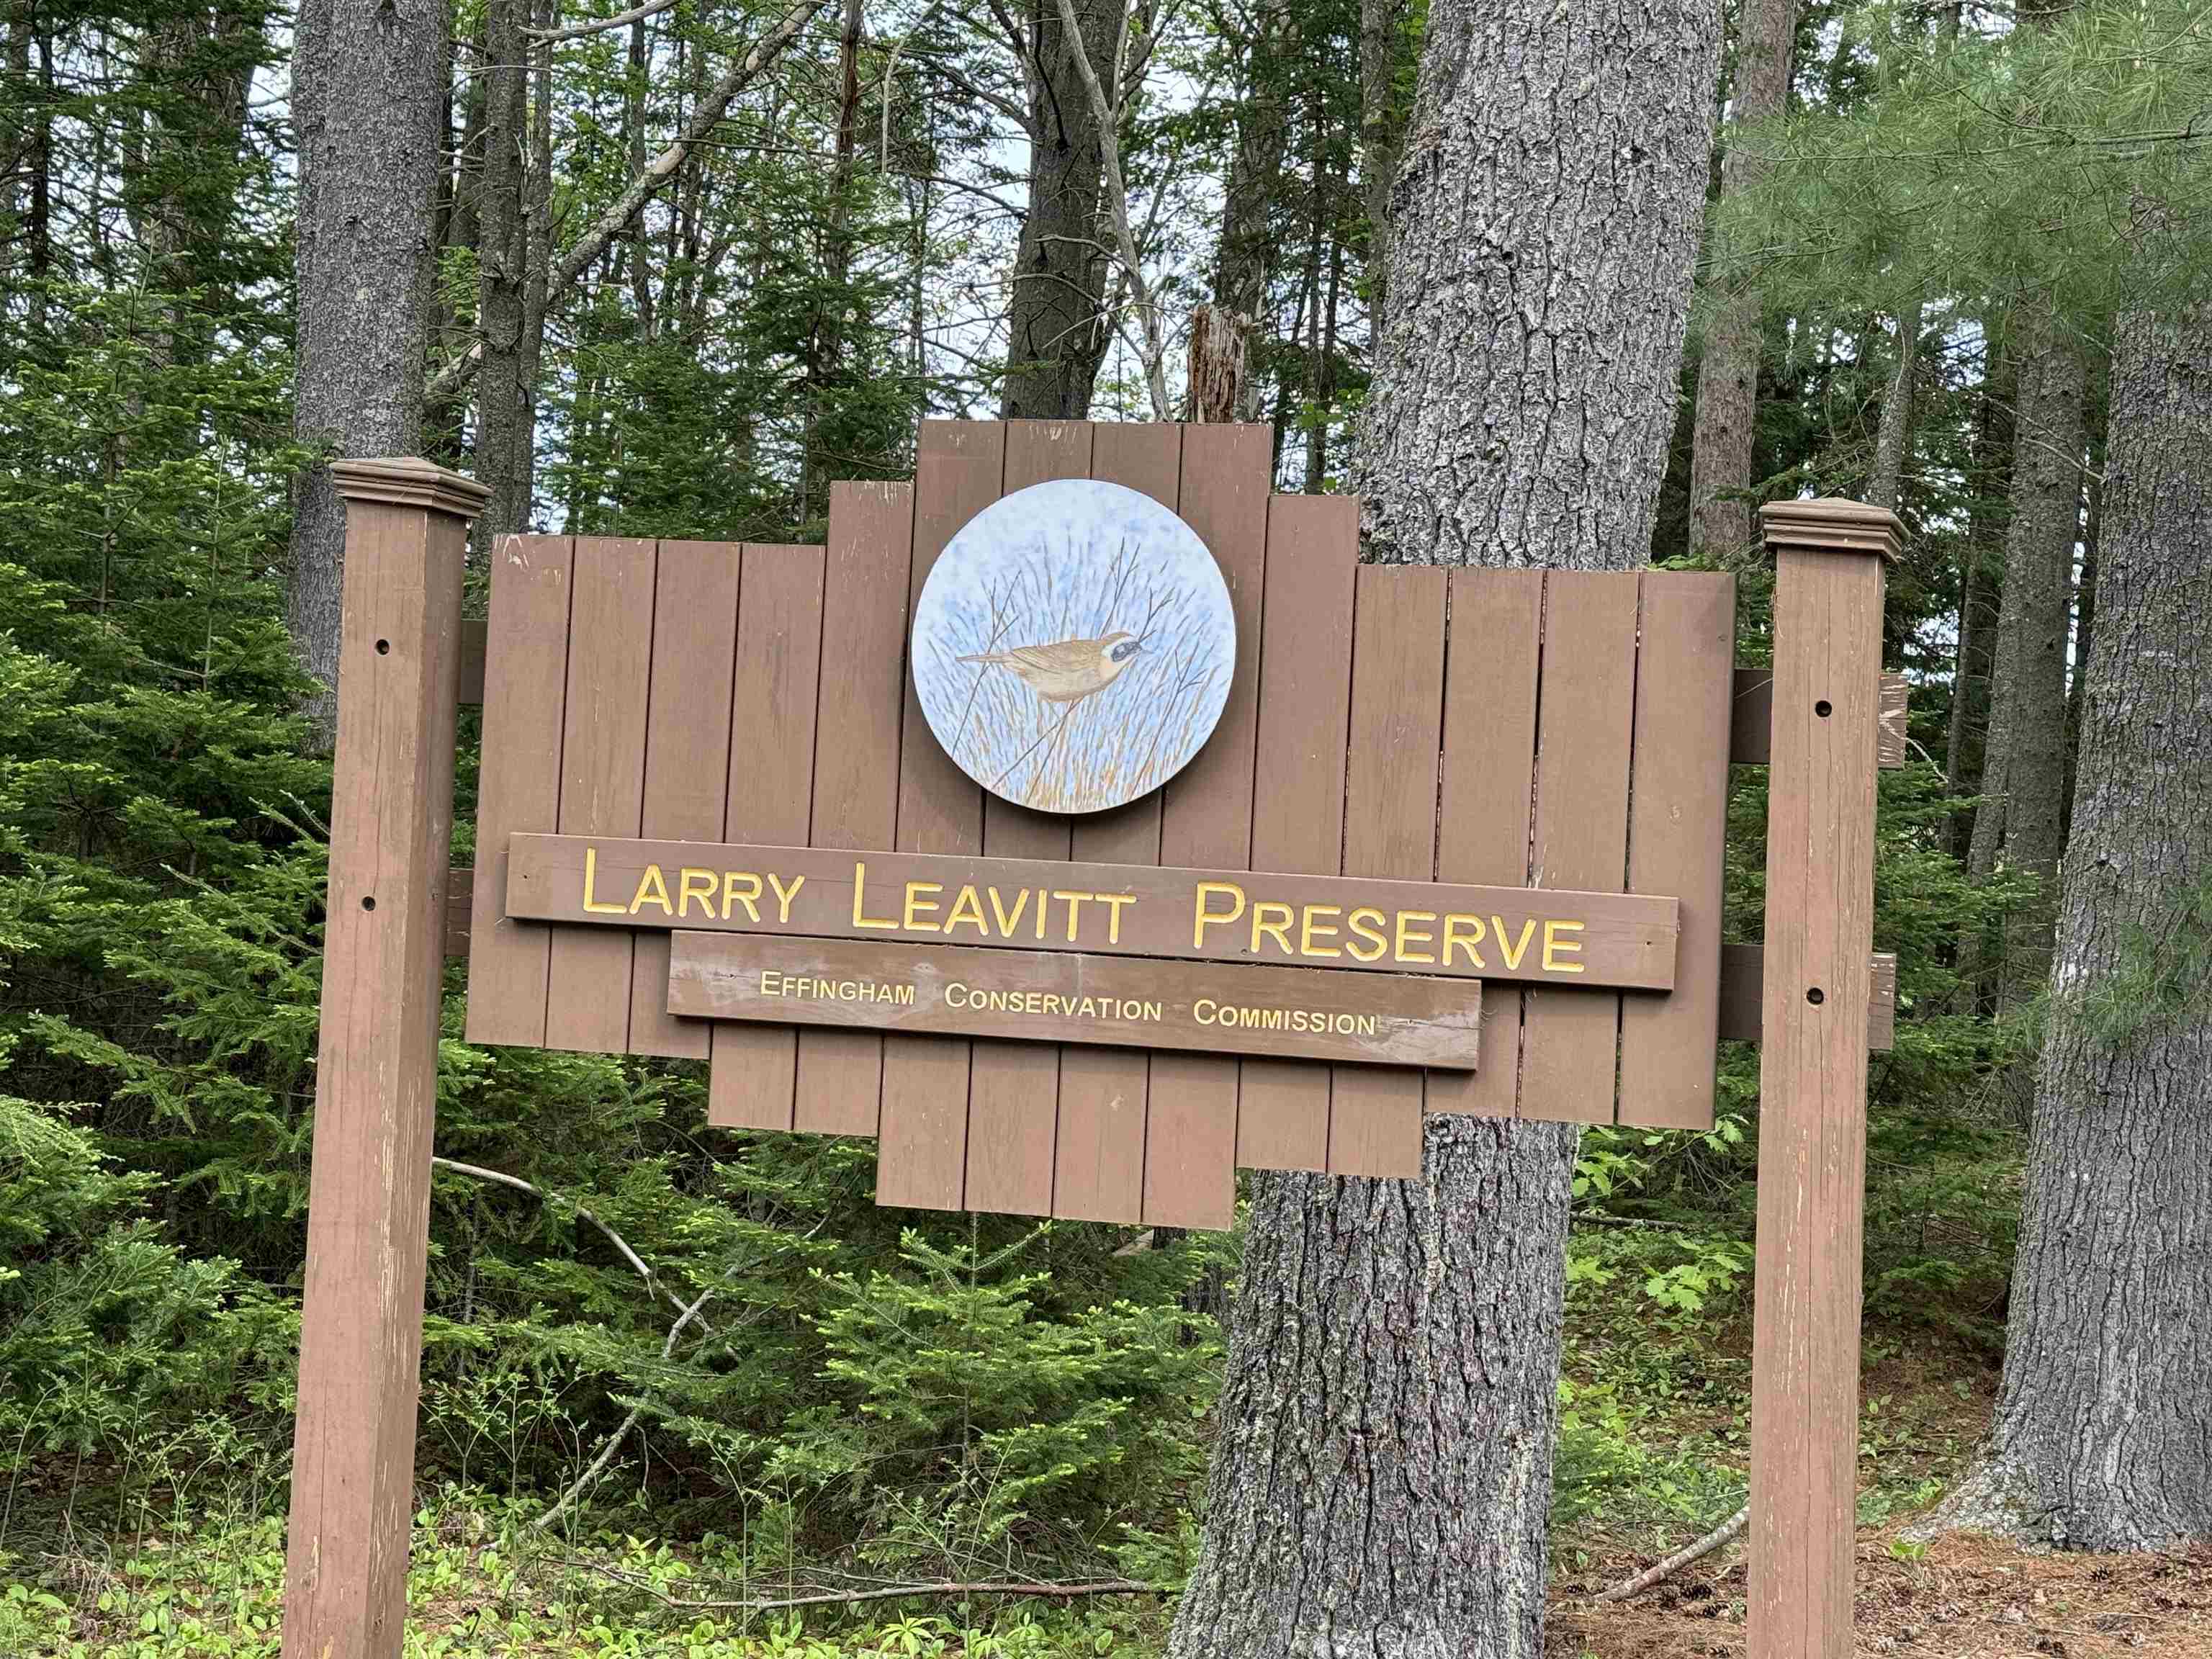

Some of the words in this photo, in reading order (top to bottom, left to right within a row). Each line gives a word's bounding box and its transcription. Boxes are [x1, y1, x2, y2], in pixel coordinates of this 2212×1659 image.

[583, 845, 805, 922] LARRY
[852, 862, 1137, 944] LEAVITT
[1193, 881, 1585, 973] PRESERVE
[760, 970, 915, 1005] EFFINGHAM
[944, 981, 1163, 1022] CONSERVATION
[1192, 998, 1376, 1035] COMMISSION
